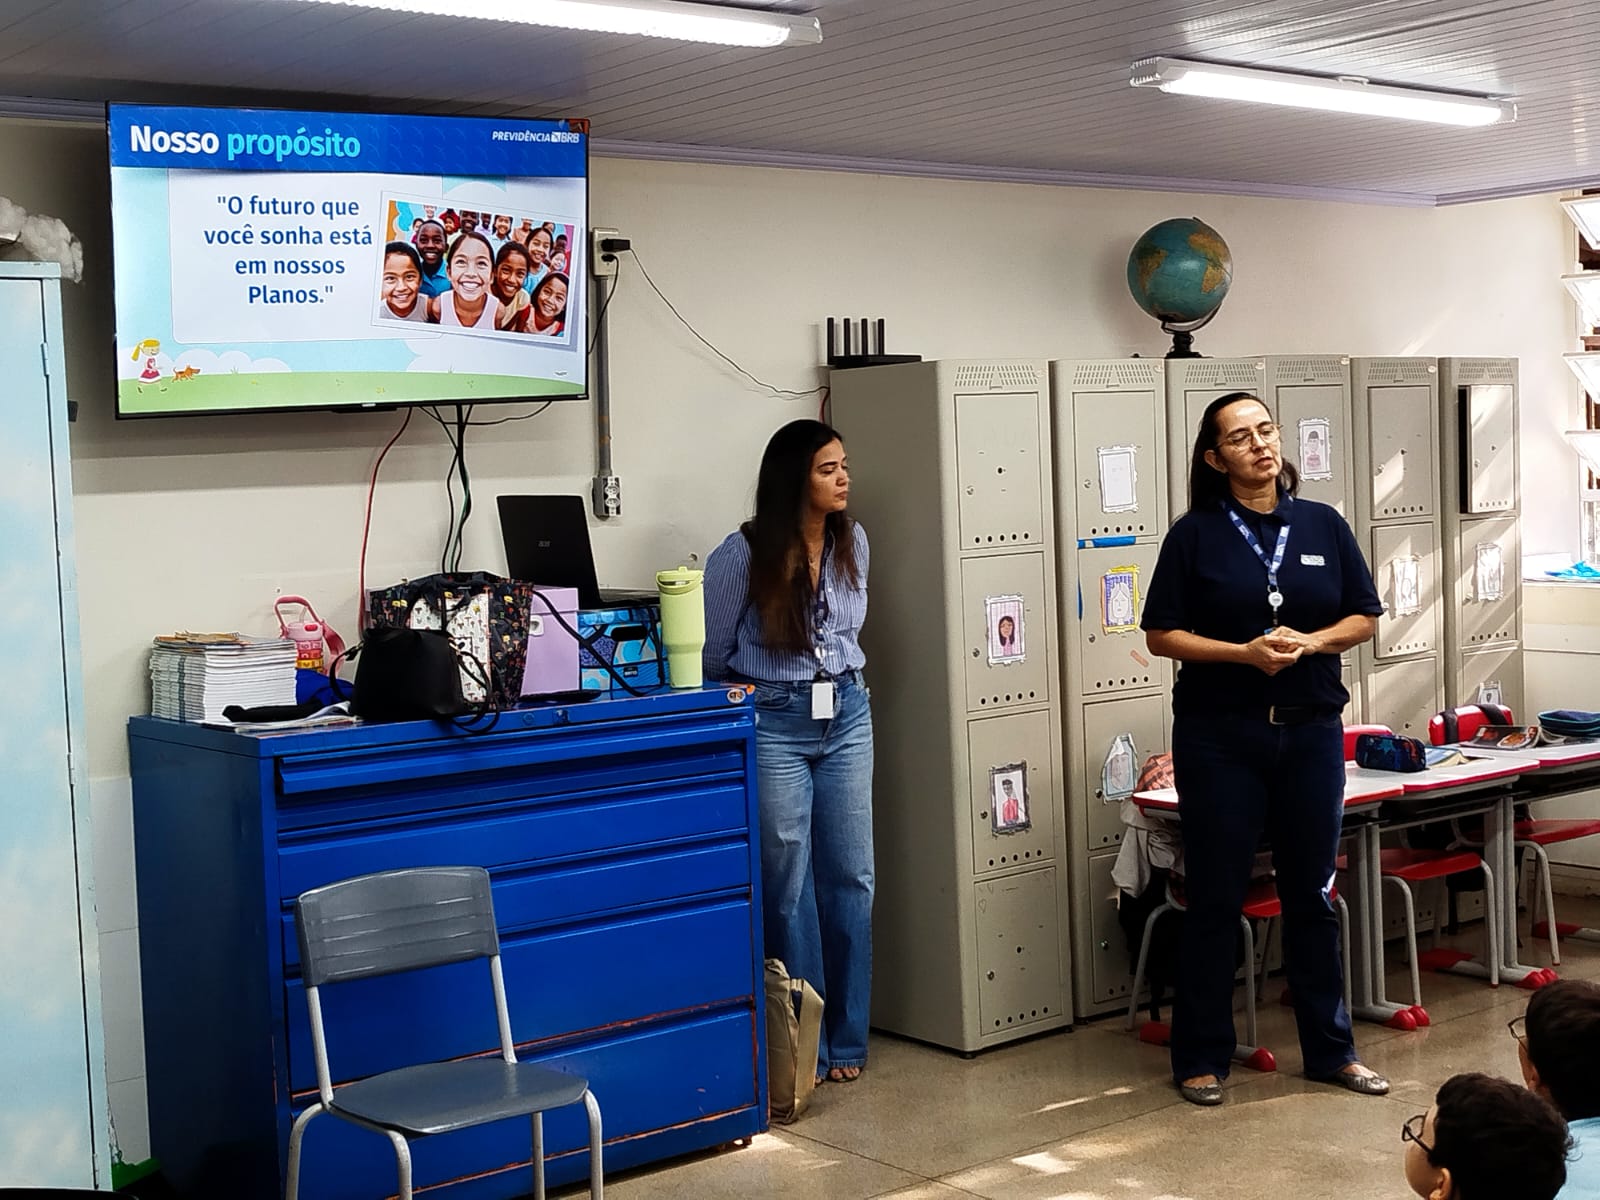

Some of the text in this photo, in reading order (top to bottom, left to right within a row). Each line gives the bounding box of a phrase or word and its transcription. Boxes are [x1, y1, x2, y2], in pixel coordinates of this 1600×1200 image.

[130, 125, 361, 162] Nosso propósito
[492, 129, 580, 144] PREVIDÊNCIA BRB
[217, 195, 360, 221] "O futuro que
[203, 223, 373, 246] você sonha está
[235, 259, 346, 275] em nossos
[248, 285, 334, 304] Planos."
